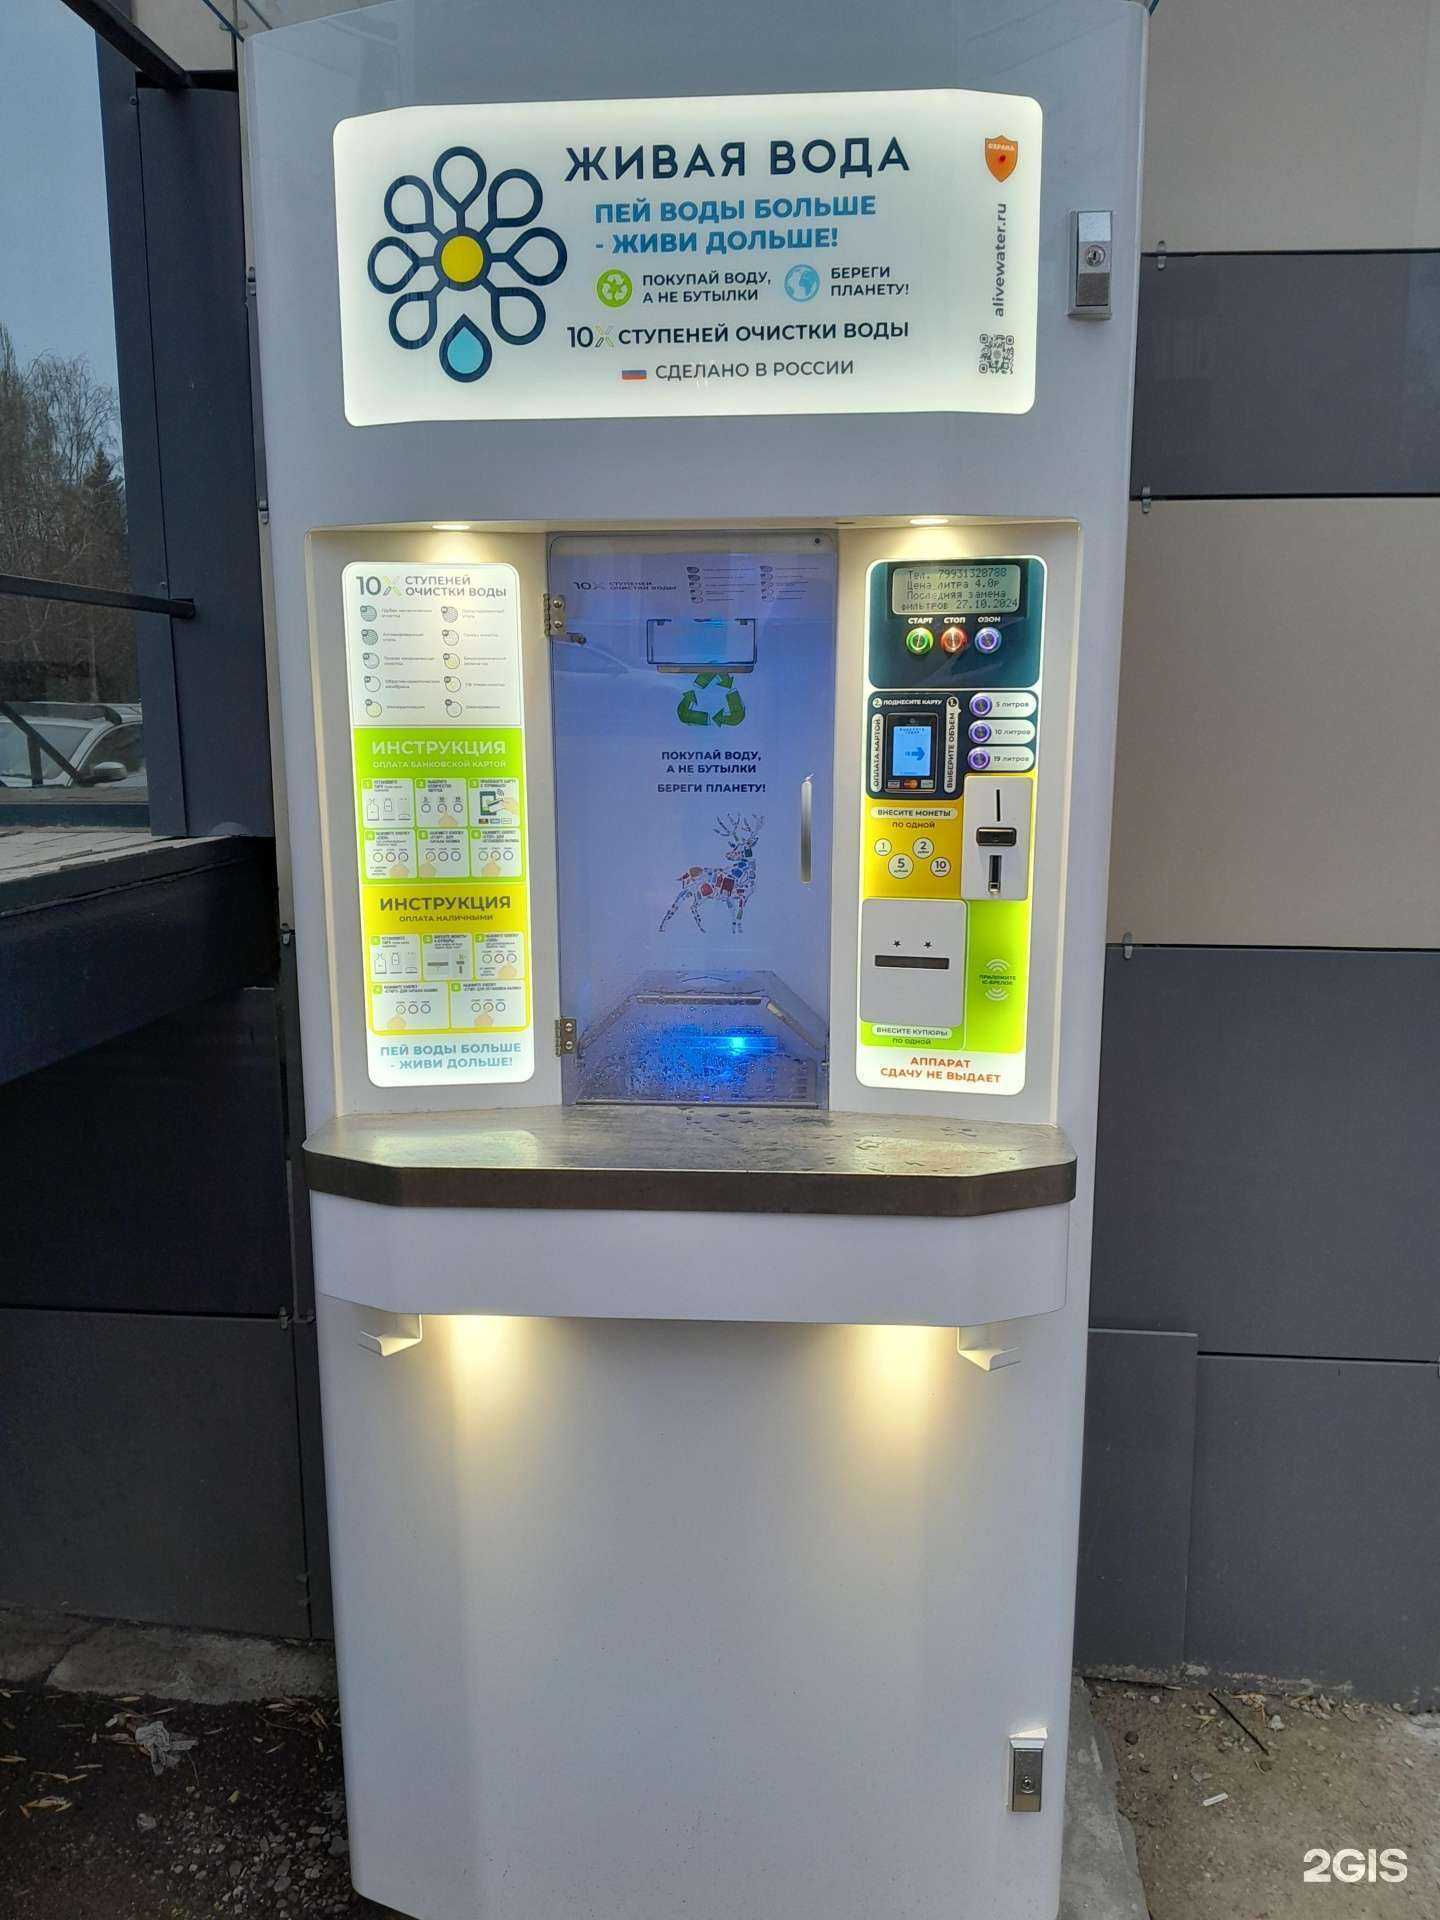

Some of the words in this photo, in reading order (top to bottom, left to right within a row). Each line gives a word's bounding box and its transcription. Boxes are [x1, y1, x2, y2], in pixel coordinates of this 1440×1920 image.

[564, 142, 746, 182] ЖИВАЯ
[770, 136, 910, 178] ВОДА
[594, 198, 650, 224] ПЕЙ
[660, 200, 745, 224] ВОДЫ
[754, 194, 876, 220] БОЛЬШЕ
[612, 232, 698, 254] ЖИВИ
[704, 228, 838, 254] ДОЛЬШЕ!
[992, 202, 1006, 318] alivewater.ru
[642, 270, 720, 288] ПОКУПАЙ
[724, 270, 772, 286] ВОДУ,
[830, 266, 890, 280] БЕРЕГИ
[642, 292, 654, 304] А
[658, 291, 678, 304] НЕ
[682, 289, 760, 303] БУТЫЛКИ
[830, 283, 910, 298] ПЛАНЕТУ!
[618, 322, 730, 346] СТУПЕНЕЙ
[736, 322, 836, 342] ОЧИСТКИ
[844, 322, 910, 340] ВОДЫ
[655, 362, 750, 382] СДЕЛАНО
[756, 362, 768, 377] В
[772, 360, 854, 377] РОССИИ
[404, 573, 471, 586] СТУПЕНЕЙ
[404, 586, 466, 598] ОЧИСТКИ
[468, 588, 507, 598] ВОДЫ
[906, 581, 932, 592] Цена
[906, 590, 963, 601] Последняя
[908, 617, 934, 625] СТАРТ
[944, 616, 966, 624] СТОП
[977, 616, 1001, 624] ОЗОН
[994, 728, 1002, 736] 10
[370, 740, 507, 758] ИНСТРУКЦИЯ
[661, 748, 722, 761] ПОКУПАЙ
[724, 750, 762, 762] ВОДУ,
[372, 760, 409, 768] ОПЛАТА
[410, 760, 470, 768] БАНКОВСКОЙ
[472, 759, 506, 768] КАРТОЙ
[666, 764, 676, 774] А
[678, 764, 694, 774] НЕ
[697, 764, 757, 774] БУТЫЛКИ
[872, 752, 880, 788] ОПЛАТА
[946, 746, 955, 788] ВЫБЕРИТЕ
[656, 784, 703, 794] БЕРЕГИ
[706, 783, 766, 794] ПЛАНЕТУ!
[877, 808, 914, 817] ВНЕСИТЕ
[914, 808, 952, 818] МОНЕТЫ
[905, 820, 936, 830] ОДНОЙ
[920, 841, 927, 850] 2
[896, 858, 906, 869] 5
[934, 860, 947, 870] 10
[380, 895, 512, 912] ИНСТРУКЦИЯ
[399, 914, 434, 922] ОПЛАТА
[436, 914, 494, 922] НАЛИЧНЫМИ
[876, 1026, 912, 1036] ВНЕСИТЕ
[912, 1028, 948, 1037] КУПЮРЫ
[904, 1038, 932, 1046] ОДНОЙ
[380, 1042, 409, 1056] ПЕЙ
[413, 1044, 456, 1056] ВОДЫ
[460, 1042, 522, 1054] БОЛЬШЕ
[399, 1058, 444, 1070] ЖИВИ
[446, 1057, 513, 1070] ДОЛЬШЕ!
[910, 1056, 972, 1070] АППАРАТ
[880, 1067, 922, 1080] СДАЧУ
[926, 1070, 942, 1080] НЕ
[946, 1072, 1002, 1084] ВЫДАЕТ
